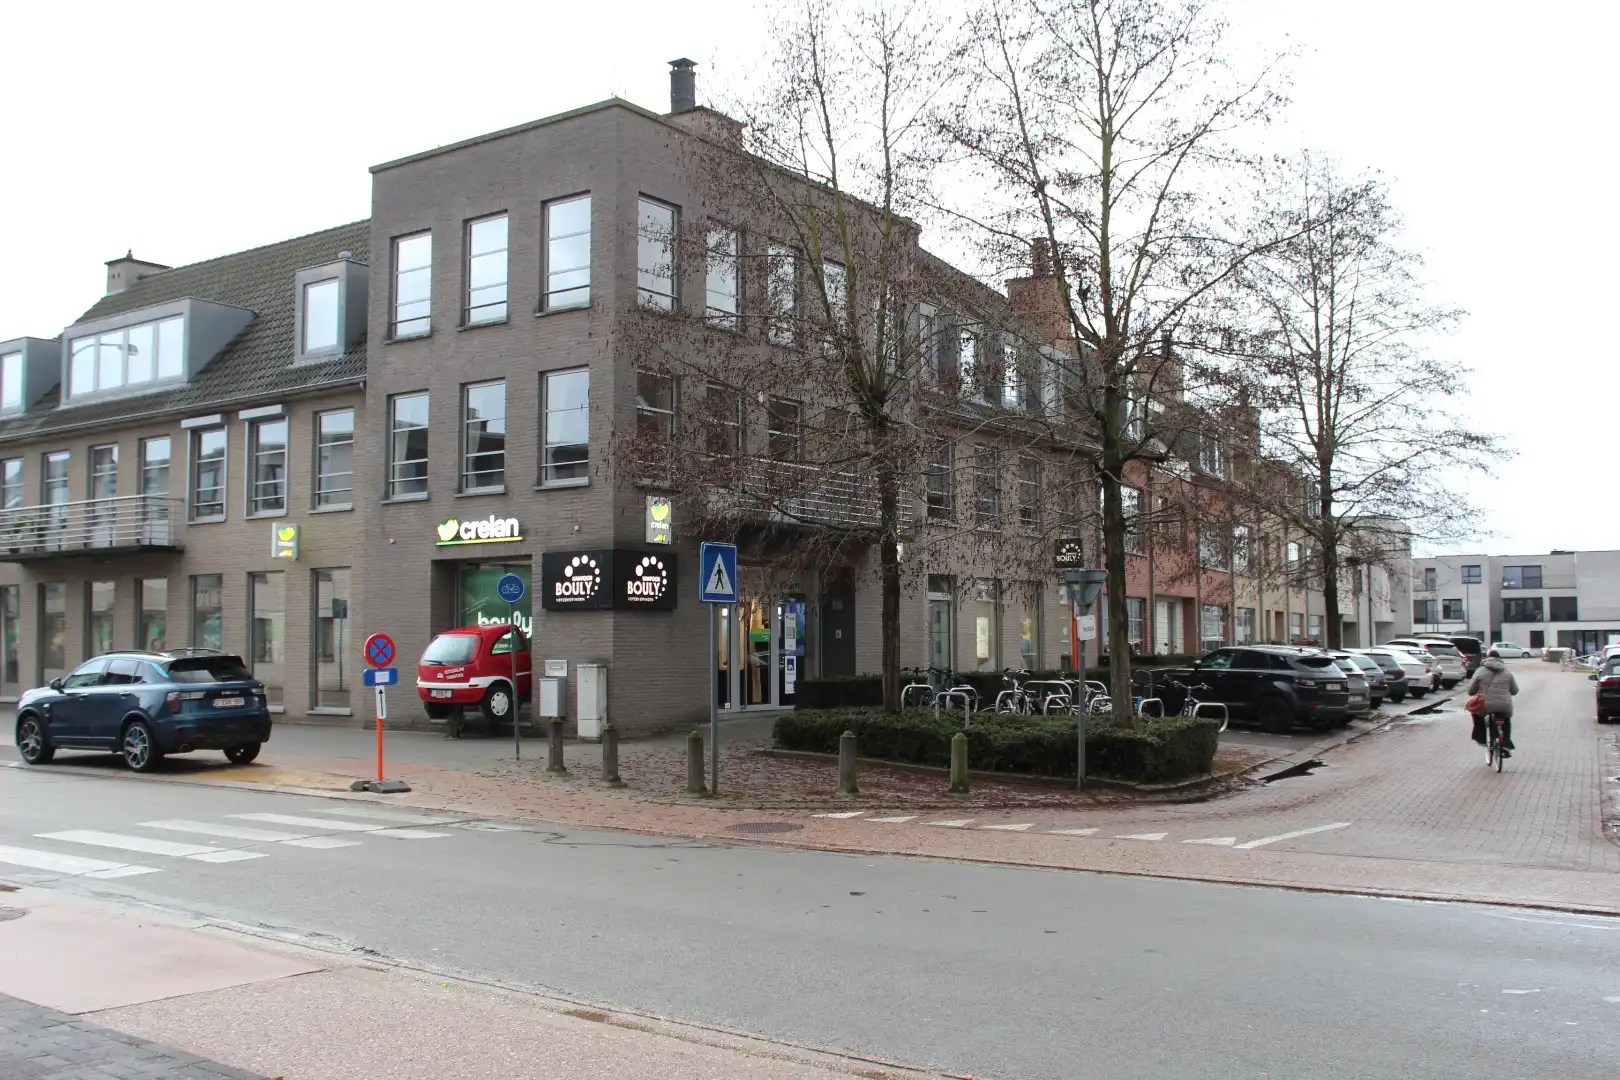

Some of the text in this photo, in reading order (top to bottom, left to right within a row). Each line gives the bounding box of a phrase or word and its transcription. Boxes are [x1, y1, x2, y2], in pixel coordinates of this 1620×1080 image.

[460, 514, 519, 540] crelan
[555, 581, 593, 596] BOULY
[627, 581, 660, 596] BOULY
